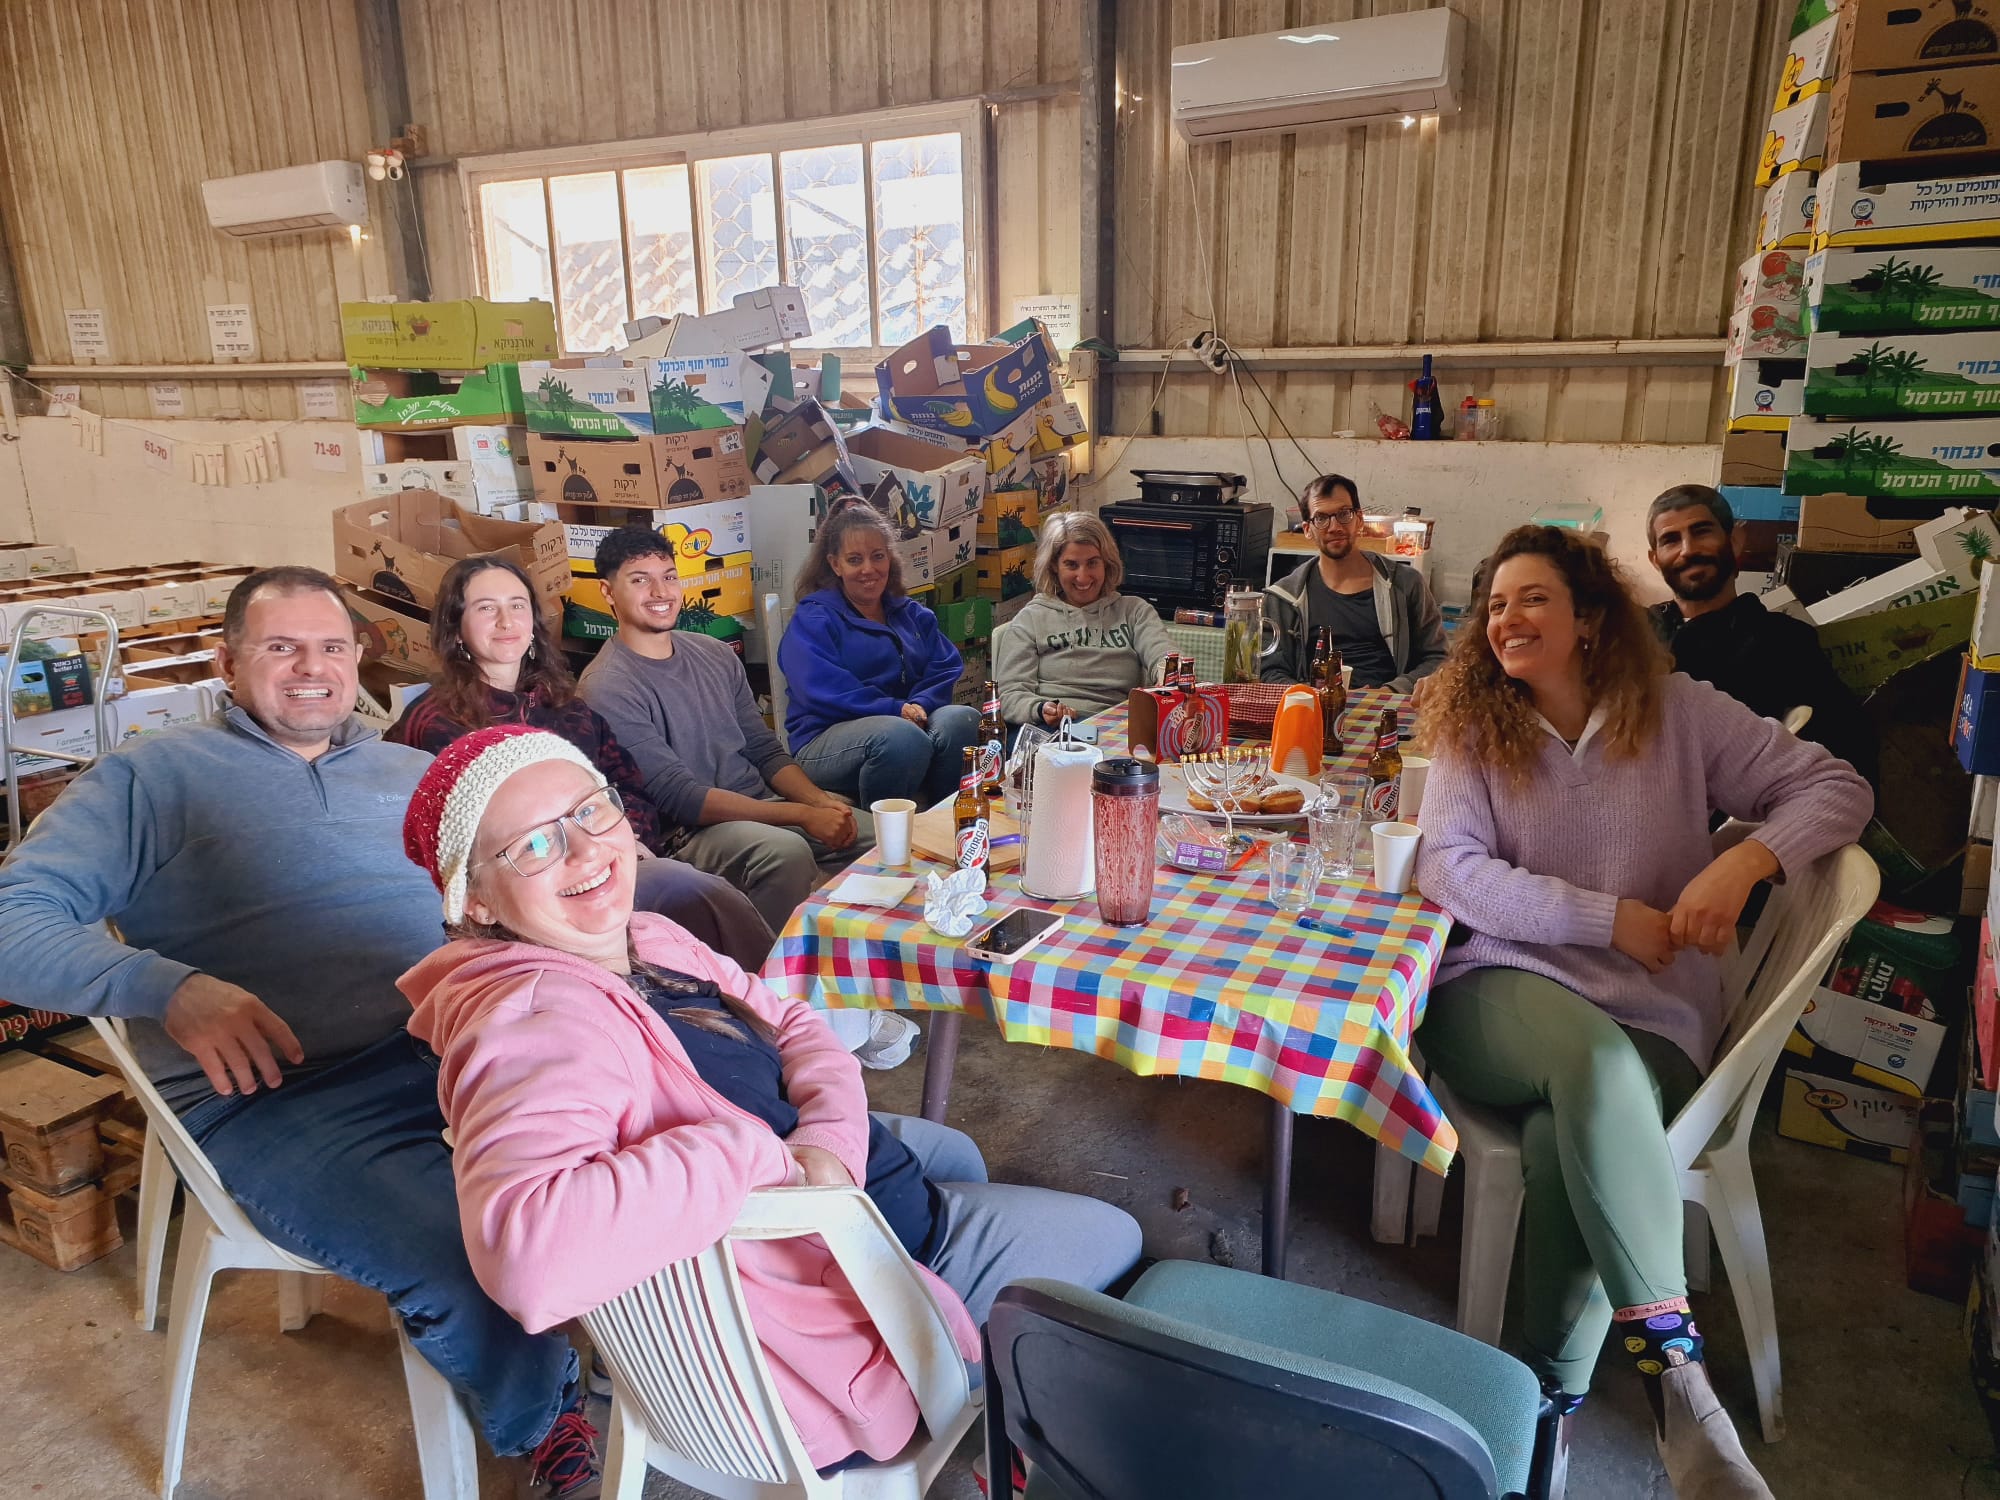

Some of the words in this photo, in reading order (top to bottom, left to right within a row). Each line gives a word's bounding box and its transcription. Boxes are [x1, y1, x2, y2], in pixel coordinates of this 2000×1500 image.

[1916, 183, 1933, 196] כל
[1935, 181, 1953, 195] על
[1909, 196, 1959, 213] והירקות
[1961, 193, 2000, 206] פירות
[1919, 304, 1983, 321] הכרמל
[657, 359, 686, 373] הכרמל
[687, 359, 704, 373] חוף
[706, 356, 729, 369] נבחרי
[1957, 360, 2000, 375] בחרי
[587, 391, 615, 405] נבחרי
[1904, 389, 1968, 407] הכרמל
[570, 415, 601, 431] הכרמל
[602, 418, 619, 433] חוף
[665, 433, 689, 446] ירקות
[144, 440, 168, 460] 61-70
[313, 441, 341, 457] 71-80
[1930, 445, 1985, 461] נבחרי
[614, 479, 638, 492] ירקות
[1882, 472, 1942, 489] הכרמל
[1948, 473, 1981, 490] חוף
[570, 525, 579, 536] כל
[579, 525, 589, 536] על
[540, 534, 565, 555] ירקות
[583, 621, 614, 636] הכרמל
[1380, 783, 1400, 814] UBORG
[959, 830, 985, 868] TUBORG
[1867, 960, 1896, 1003] רקות
